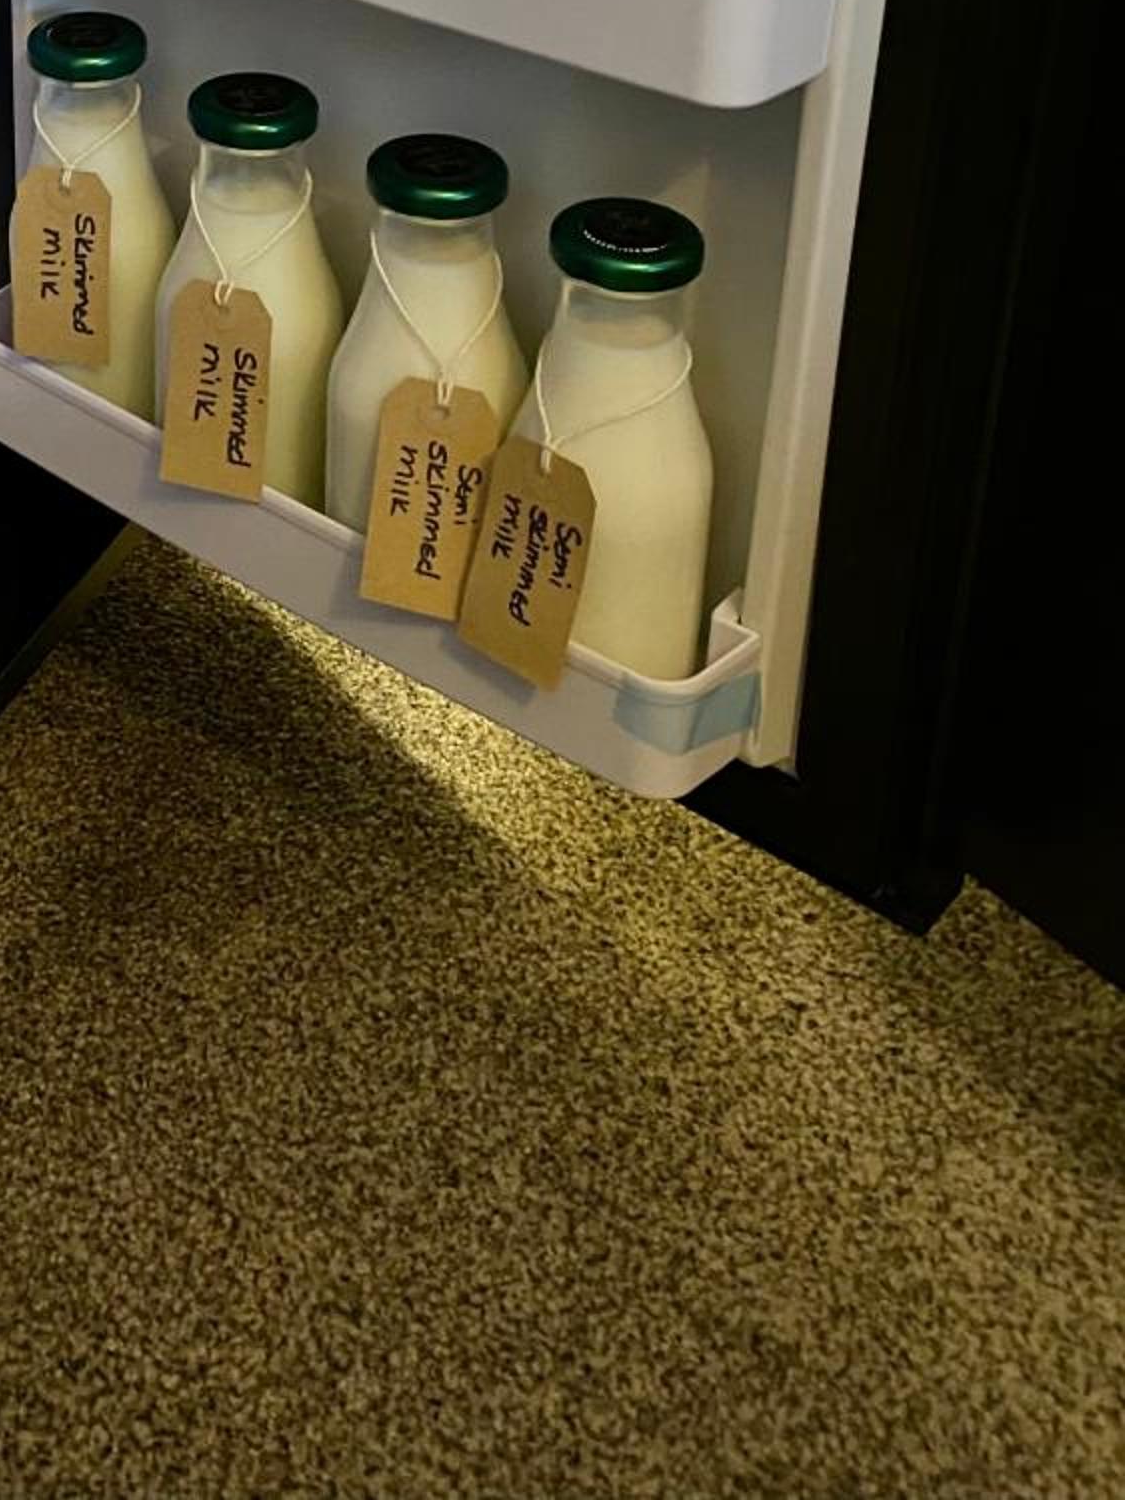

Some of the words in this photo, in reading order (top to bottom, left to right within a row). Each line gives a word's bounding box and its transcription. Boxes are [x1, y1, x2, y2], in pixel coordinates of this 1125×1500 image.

[40, 226, 67, 300] milk
[193, 342, 223, 422] milk
[390, 444, 420, 517] milk
[454, 464, 483, 526] Semi
[490, 492, 524, 560] milk
[548, 521, 583, 591] Semi
